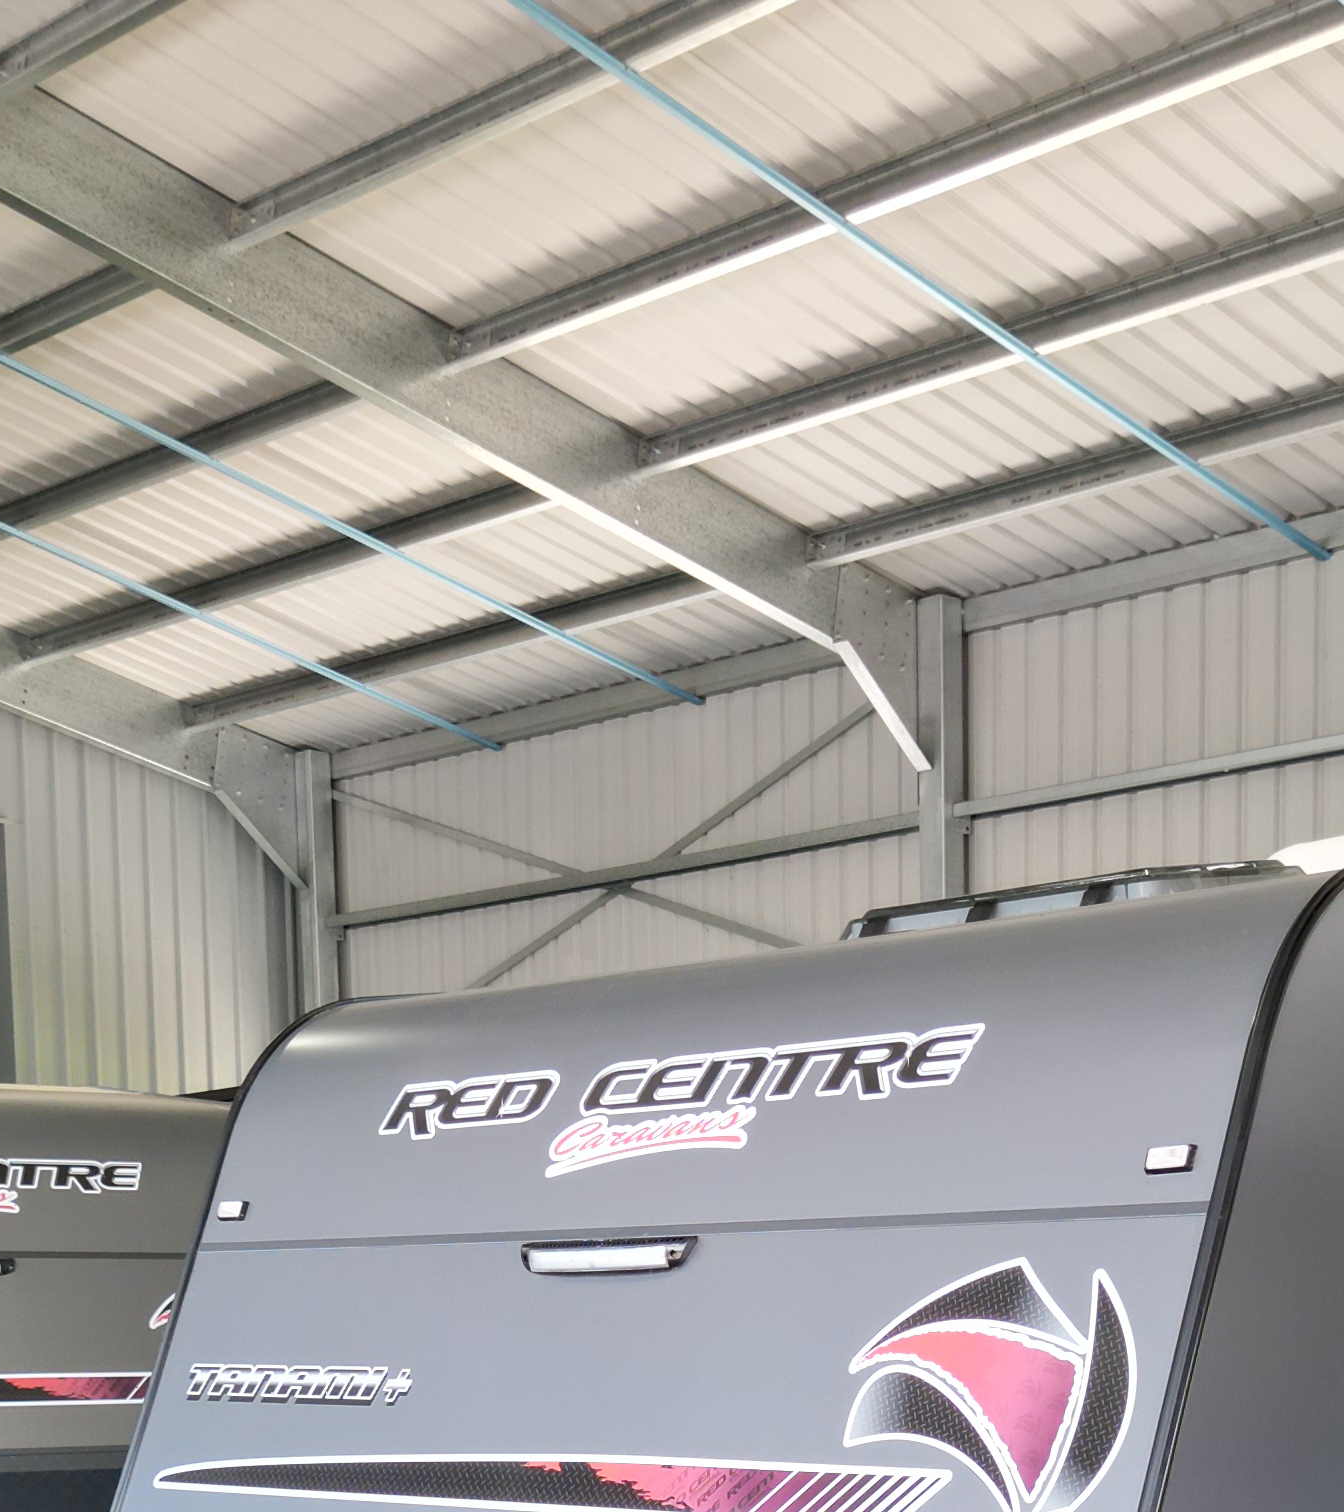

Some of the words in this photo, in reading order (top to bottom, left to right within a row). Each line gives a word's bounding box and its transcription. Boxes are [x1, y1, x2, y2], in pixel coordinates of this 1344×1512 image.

[378, 1070, 560, 1140] RED
[580, 1022, 985, 1116] CENTRE
[548, 1106, 756, 1165] Caravans
